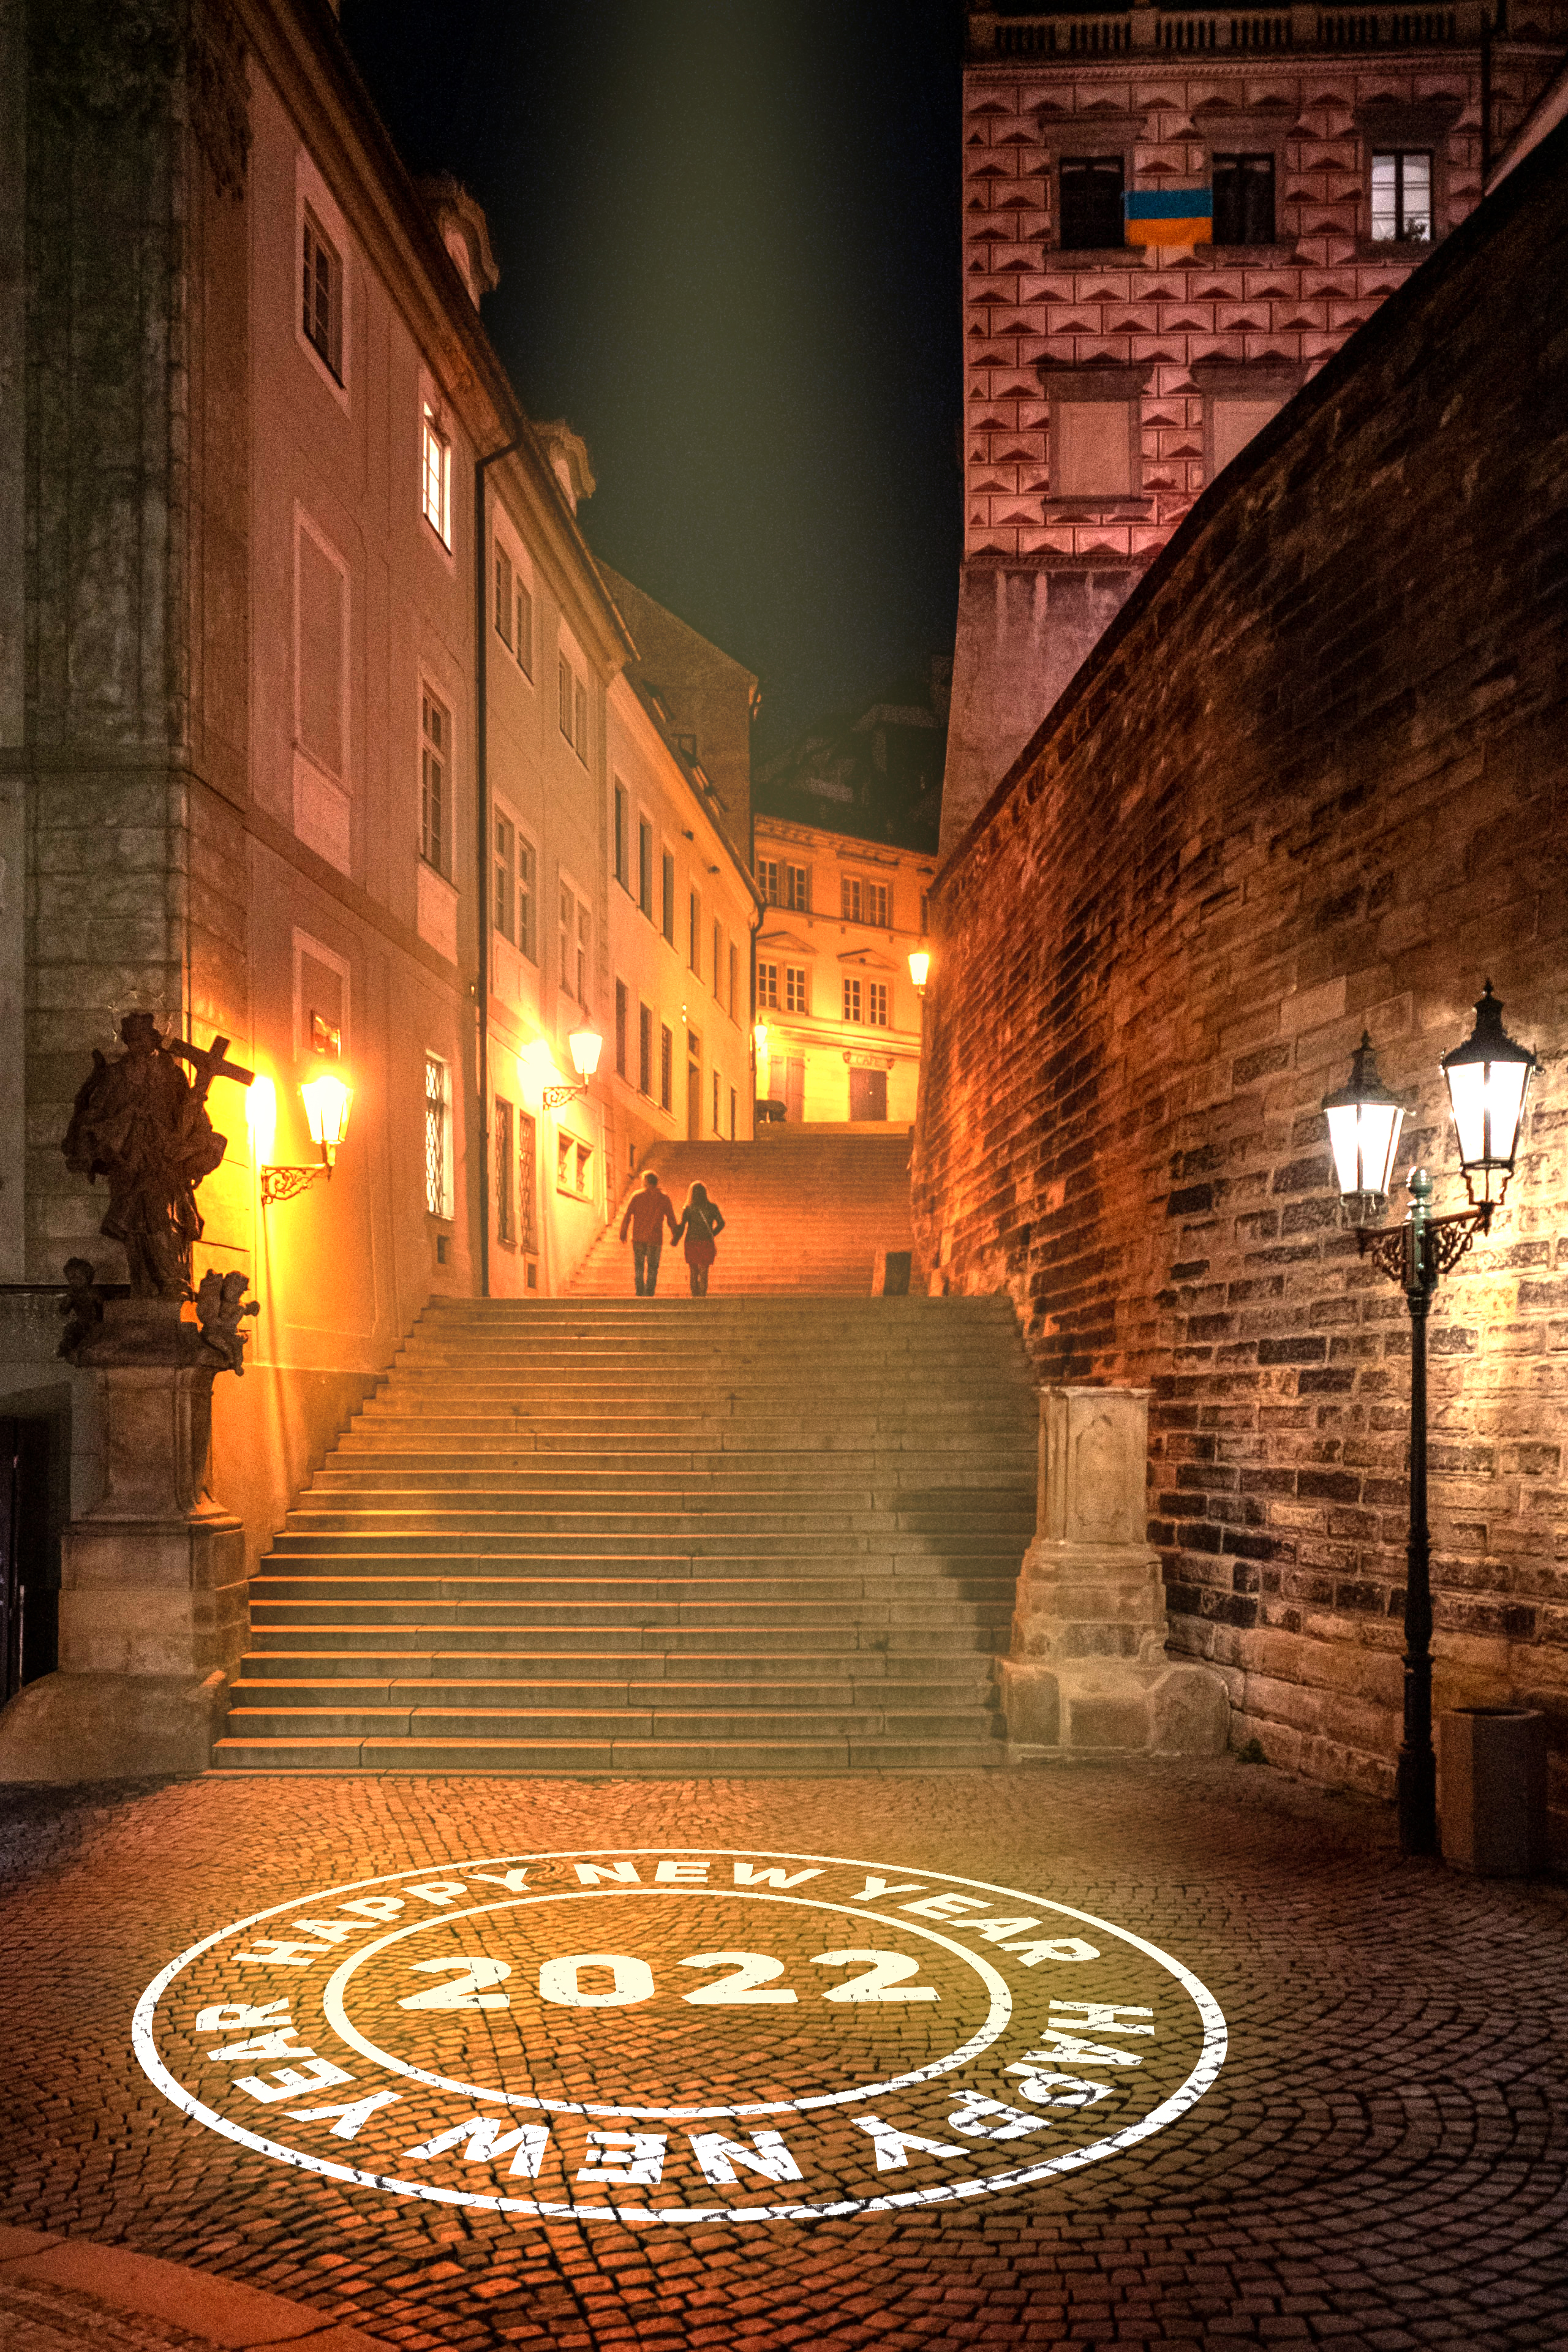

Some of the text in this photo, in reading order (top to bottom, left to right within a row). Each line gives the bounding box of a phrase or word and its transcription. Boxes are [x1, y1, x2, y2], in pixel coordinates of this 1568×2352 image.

[230, 1861, 1101, 1967] HAPPY NEW YEAR
[396, 1949, 941, 2010] 2022
[195, 1997, 1155, 2185] HAPPY NEW YEAR
